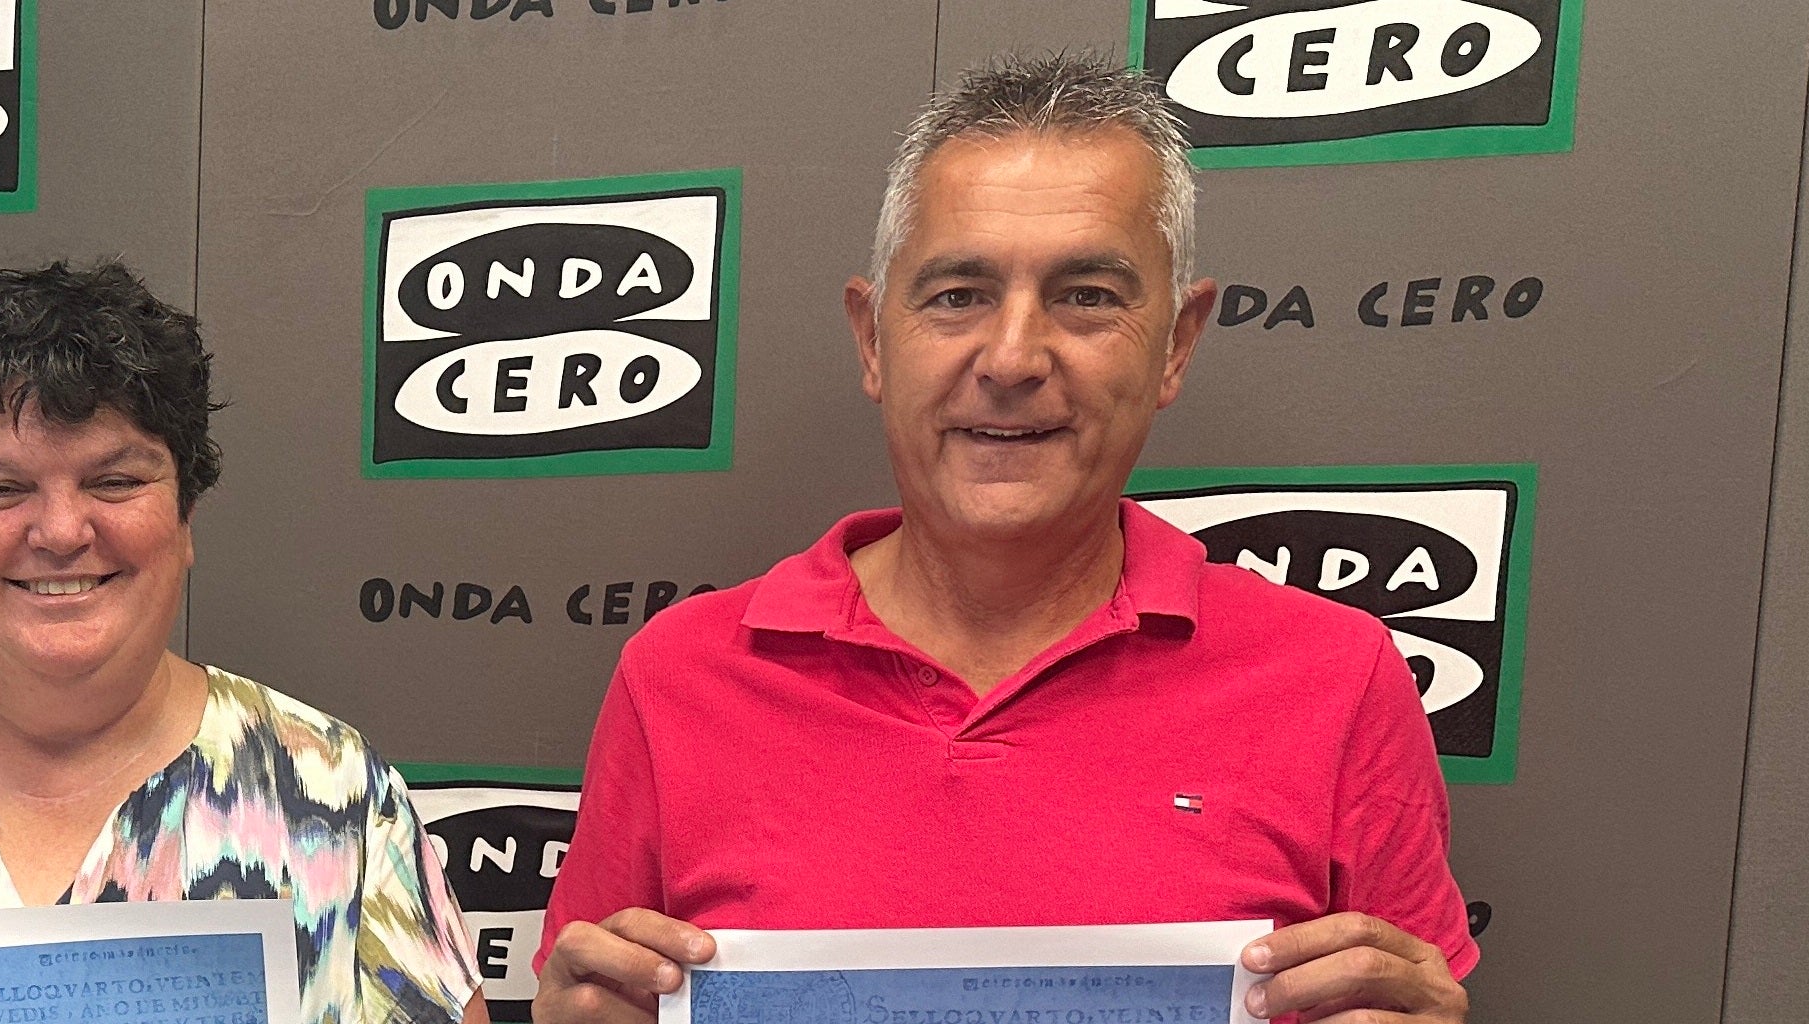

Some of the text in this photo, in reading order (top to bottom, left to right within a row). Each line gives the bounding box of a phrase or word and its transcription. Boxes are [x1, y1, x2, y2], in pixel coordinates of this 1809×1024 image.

[1217, 22, 1491, 95] CERO
[426, 252, 662, 310] ONDA
[1217, 275, 1544, 330] DA CERO
[435, 352, 660, 414] CERO
[1236, 546, 1440, 591] NDA
[360, 578, 719, 625] ONDA CER
